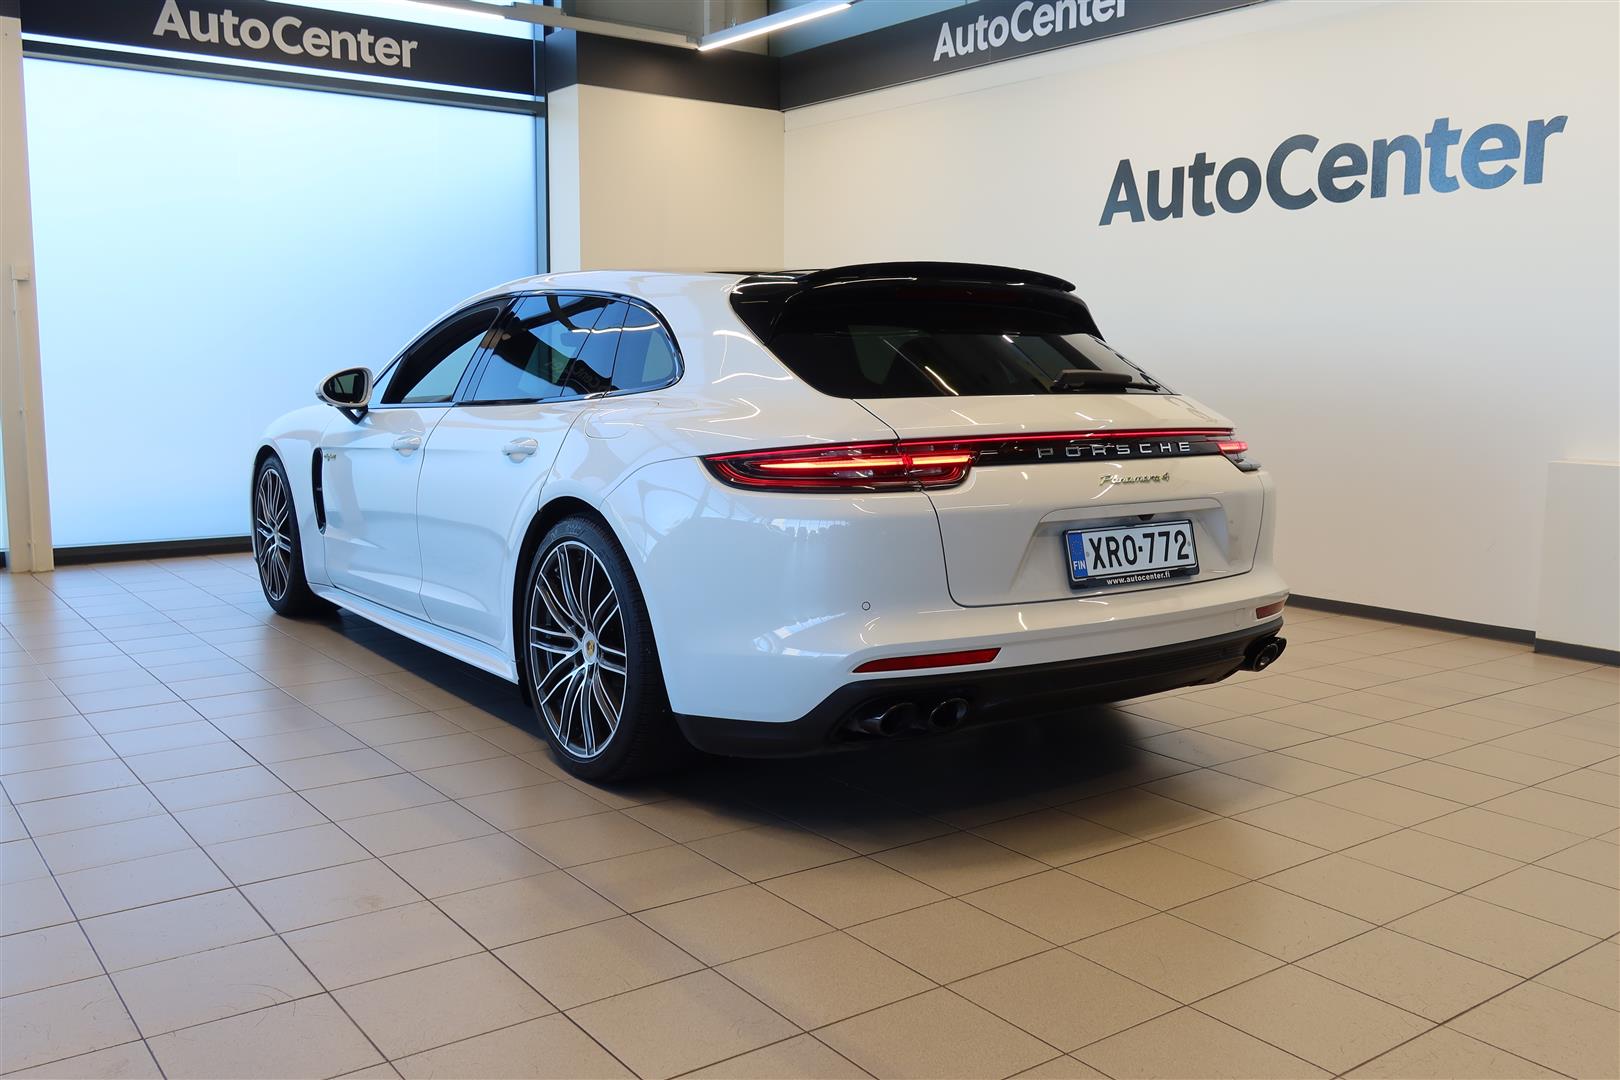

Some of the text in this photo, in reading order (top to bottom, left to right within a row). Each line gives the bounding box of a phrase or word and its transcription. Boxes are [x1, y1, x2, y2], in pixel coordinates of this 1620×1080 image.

[153, 0, 418, 68] AutoCenter
[1099, 115, 1568, 226] AutoCenter
[1037, 441, 1191, 459] PORSCHE
[1088, 529, 1190, 570] XRO-772
[1073, 560, 1086, 571] FIN
[1106, 570, 1171, 585] www.autocenter.fi
